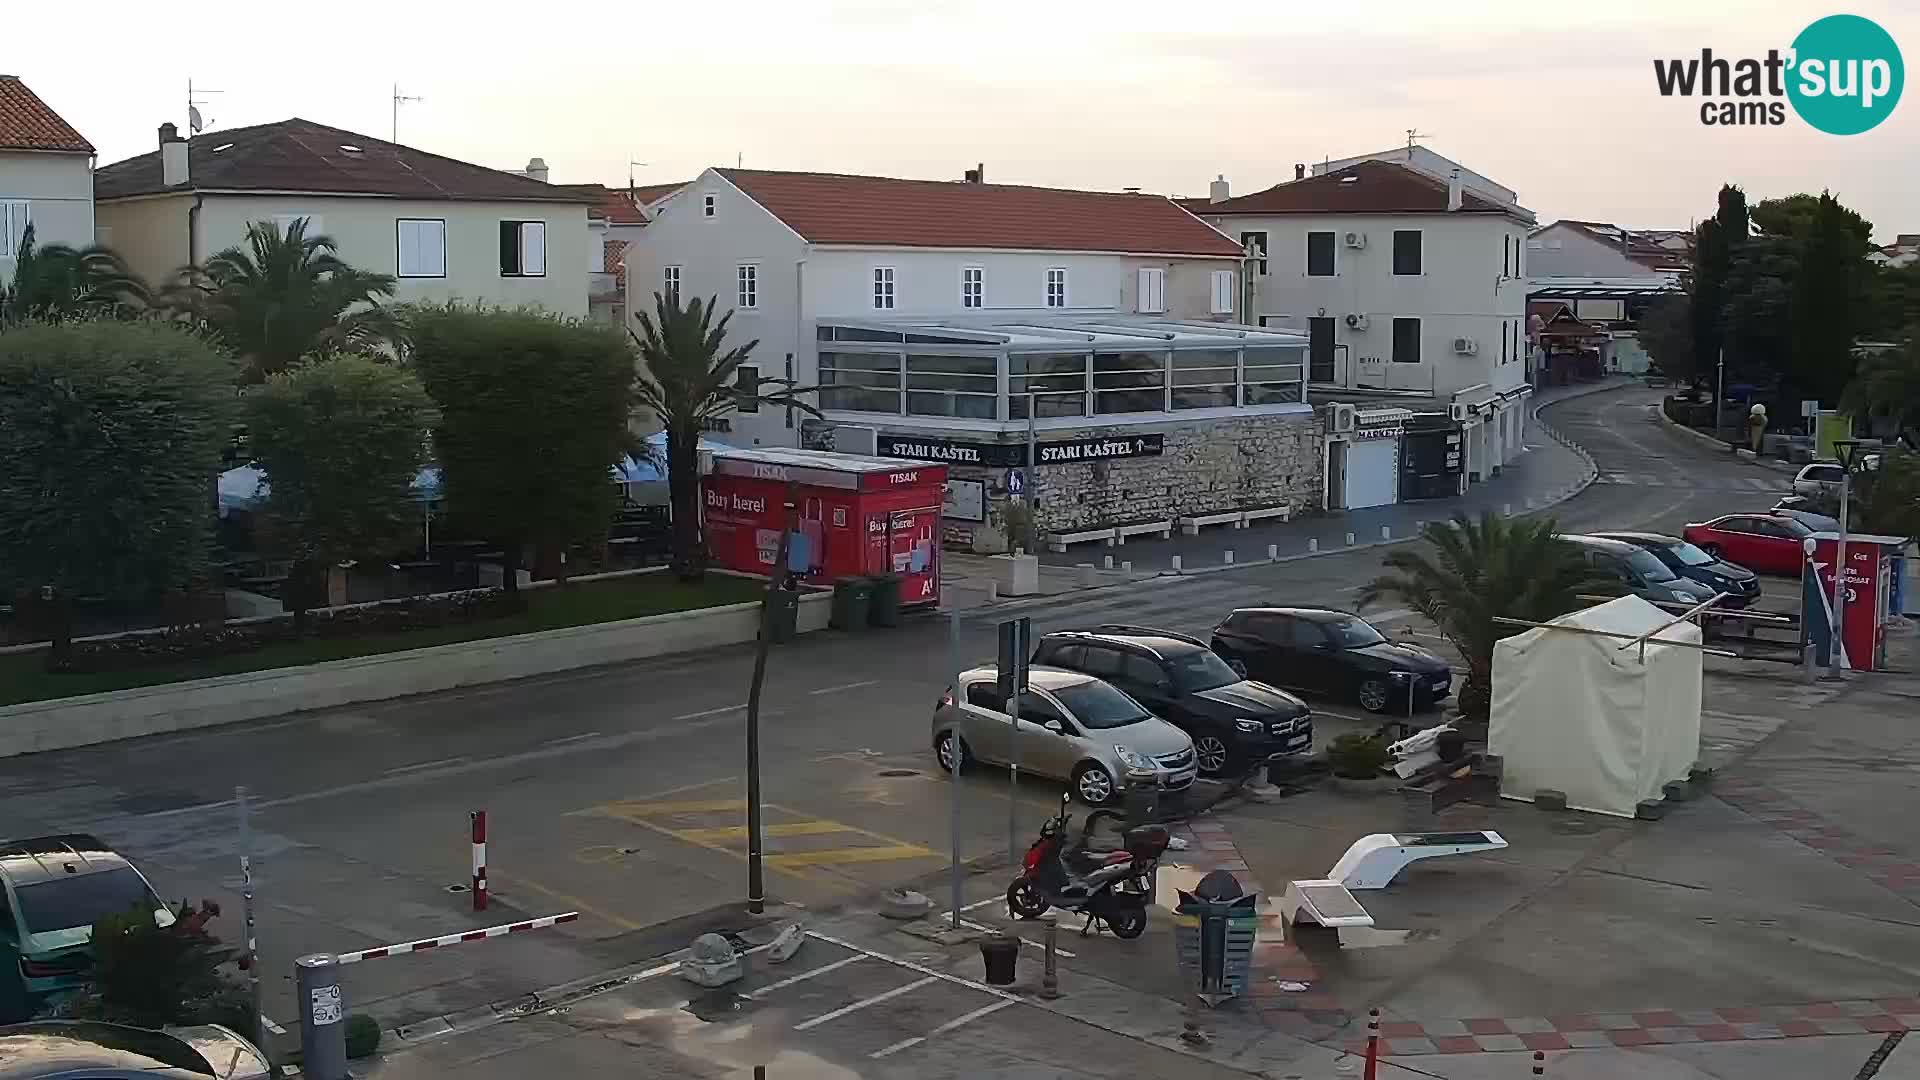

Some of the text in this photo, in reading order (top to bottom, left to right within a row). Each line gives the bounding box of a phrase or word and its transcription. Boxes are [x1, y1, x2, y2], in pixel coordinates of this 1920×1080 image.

[892, 443, 981, 462] STARI KAŠTEL
[1041, 440, 1133, 460] STARI KAŠTEL
[752, 464, 788, 480] TISAK
[889, 471, 918, 484] TISAK
[707, 489, 765, 513] Buy here!
[869, 520, 887, 533] Buy
